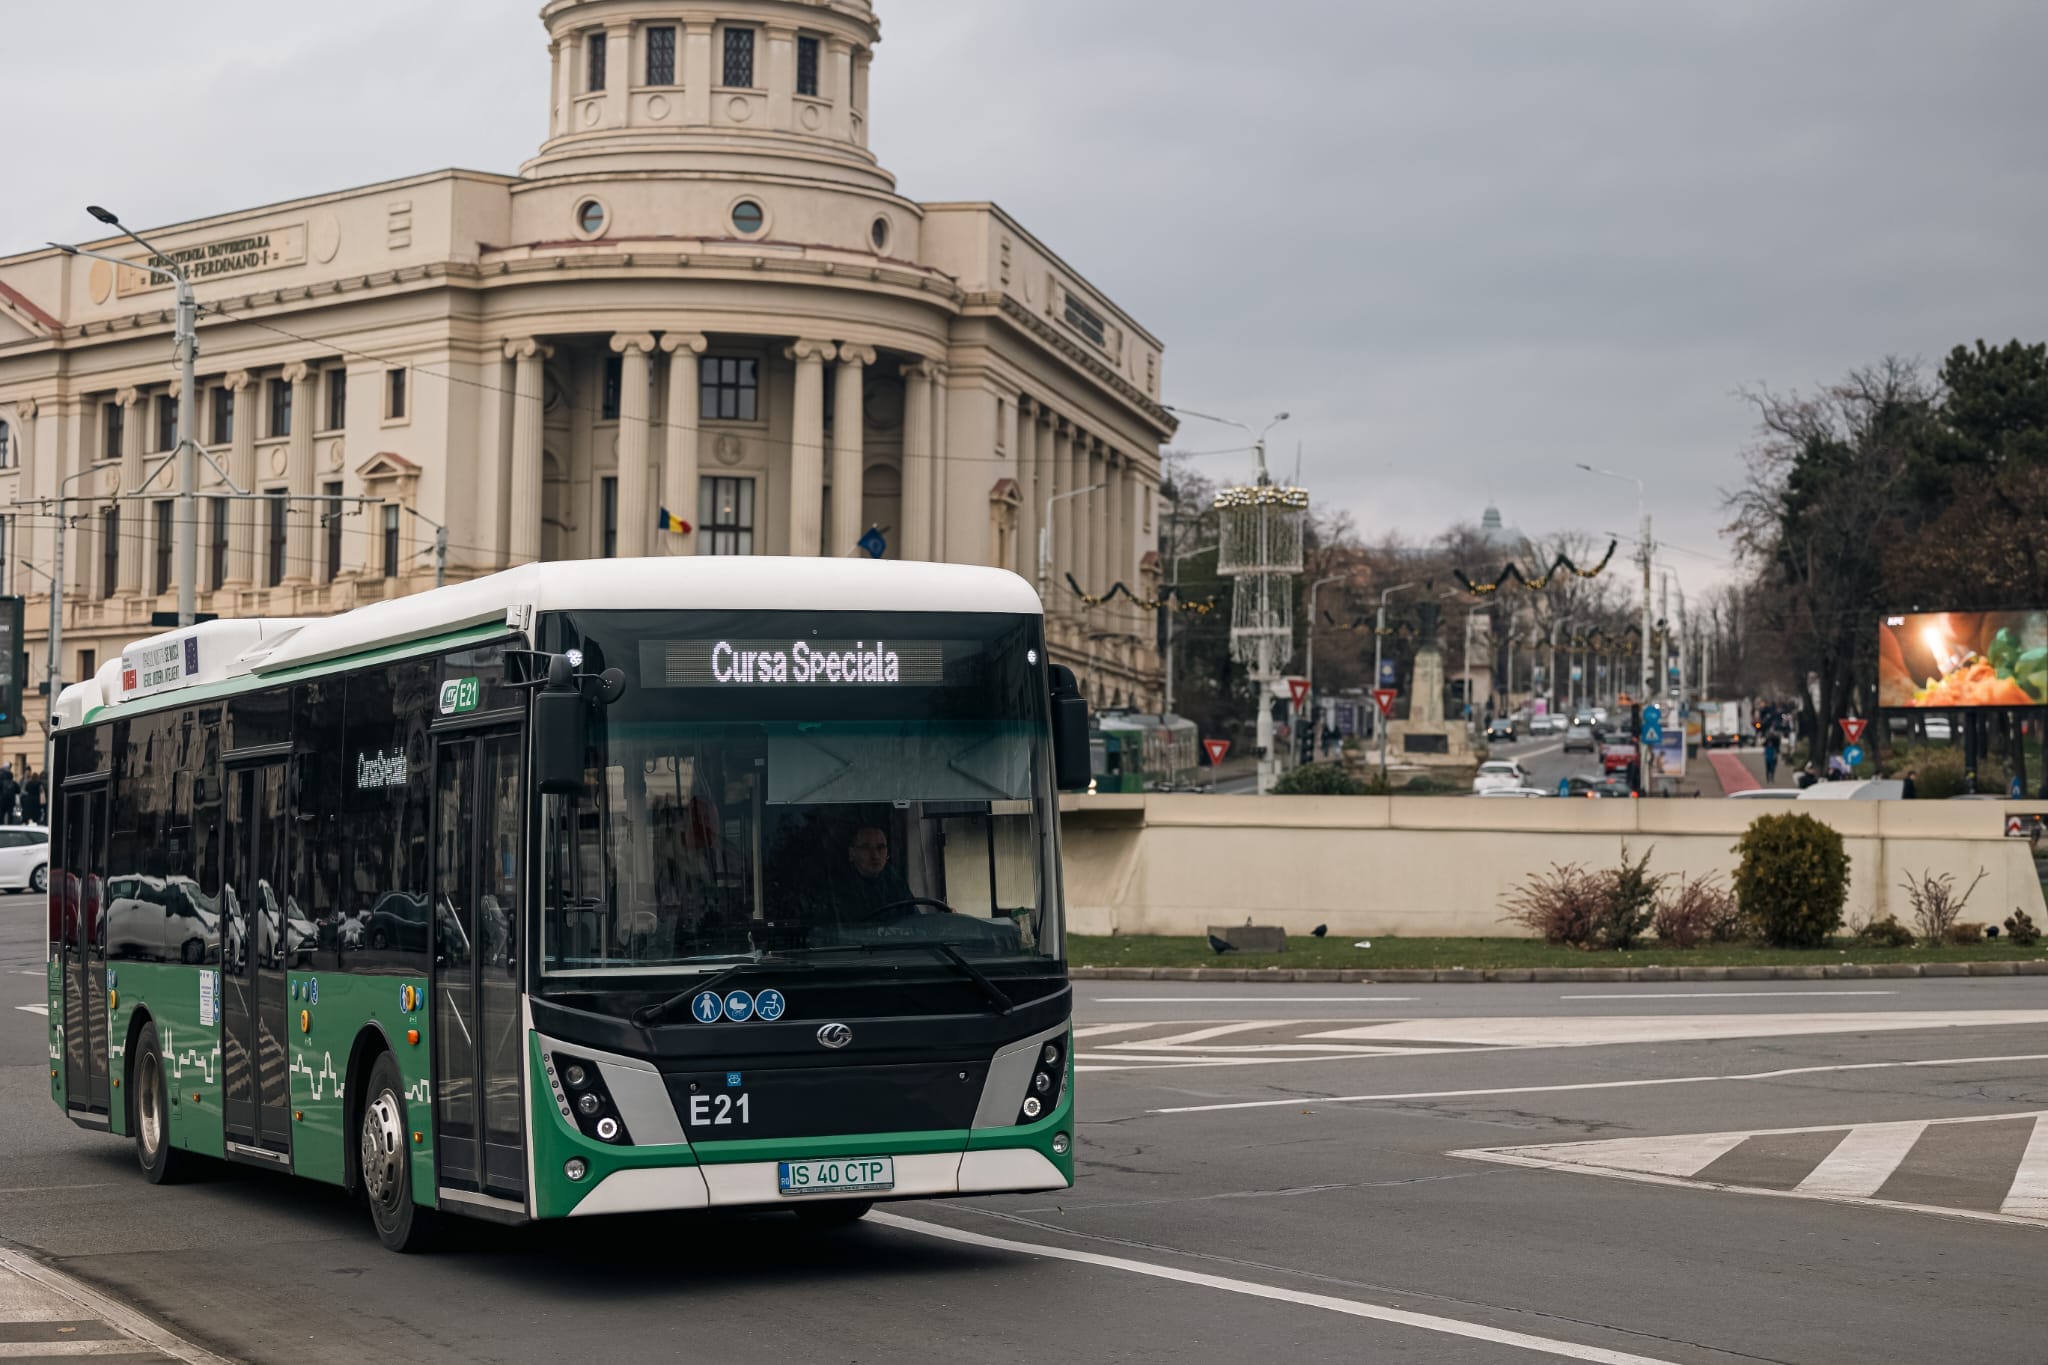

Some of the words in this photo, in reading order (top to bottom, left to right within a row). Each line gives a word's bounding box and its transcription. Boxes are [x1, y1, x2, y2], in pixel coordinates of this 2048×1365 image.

[712, 641, 787, 682] Cursa
[792, 641, 899, 682] Speciala
[459, 681, 477, 707] E21
[690, 1093, 749, 1126] E21
[791, 1165, 810, 1186] IS
[817, 1164, 840, 1184] 40
[845, 1162, 883, 1182] CTP
